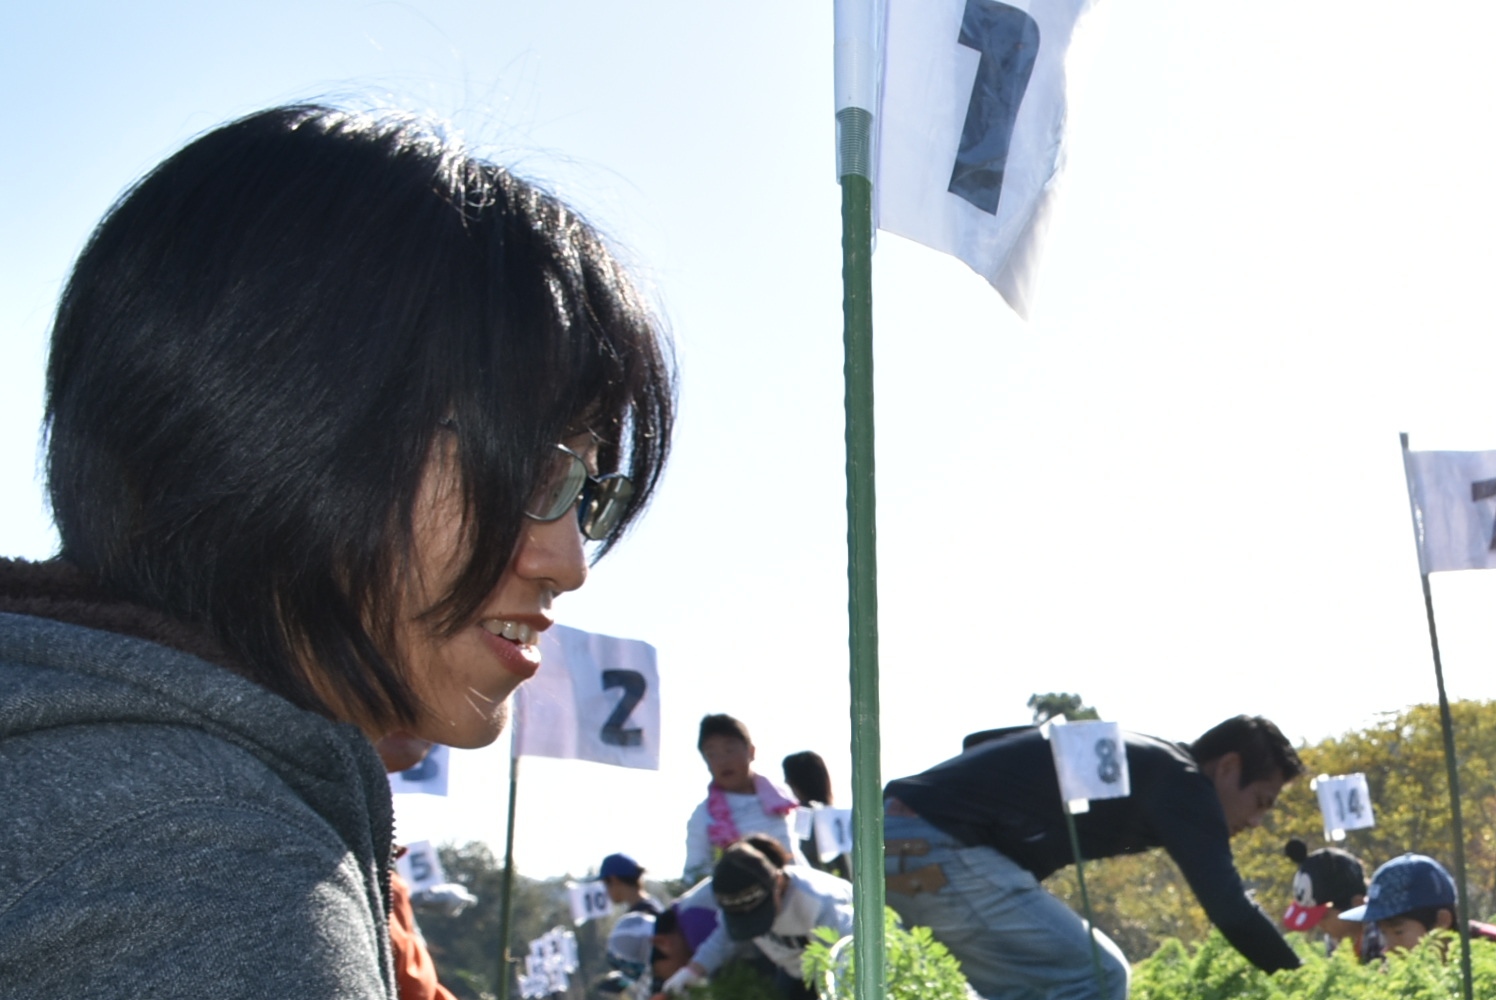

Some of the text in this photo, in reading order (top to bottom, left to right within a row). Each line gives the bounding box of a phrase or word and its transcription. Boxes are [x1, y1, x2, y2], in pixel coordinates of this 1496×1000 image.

[601, 669, 646, 746] 2
[1095, 738, 1120, 784] 8
[1334, 787, 1364, 821] 14
[410, 852, 431, 881] 5
[585, 892, 607, 912] 10
